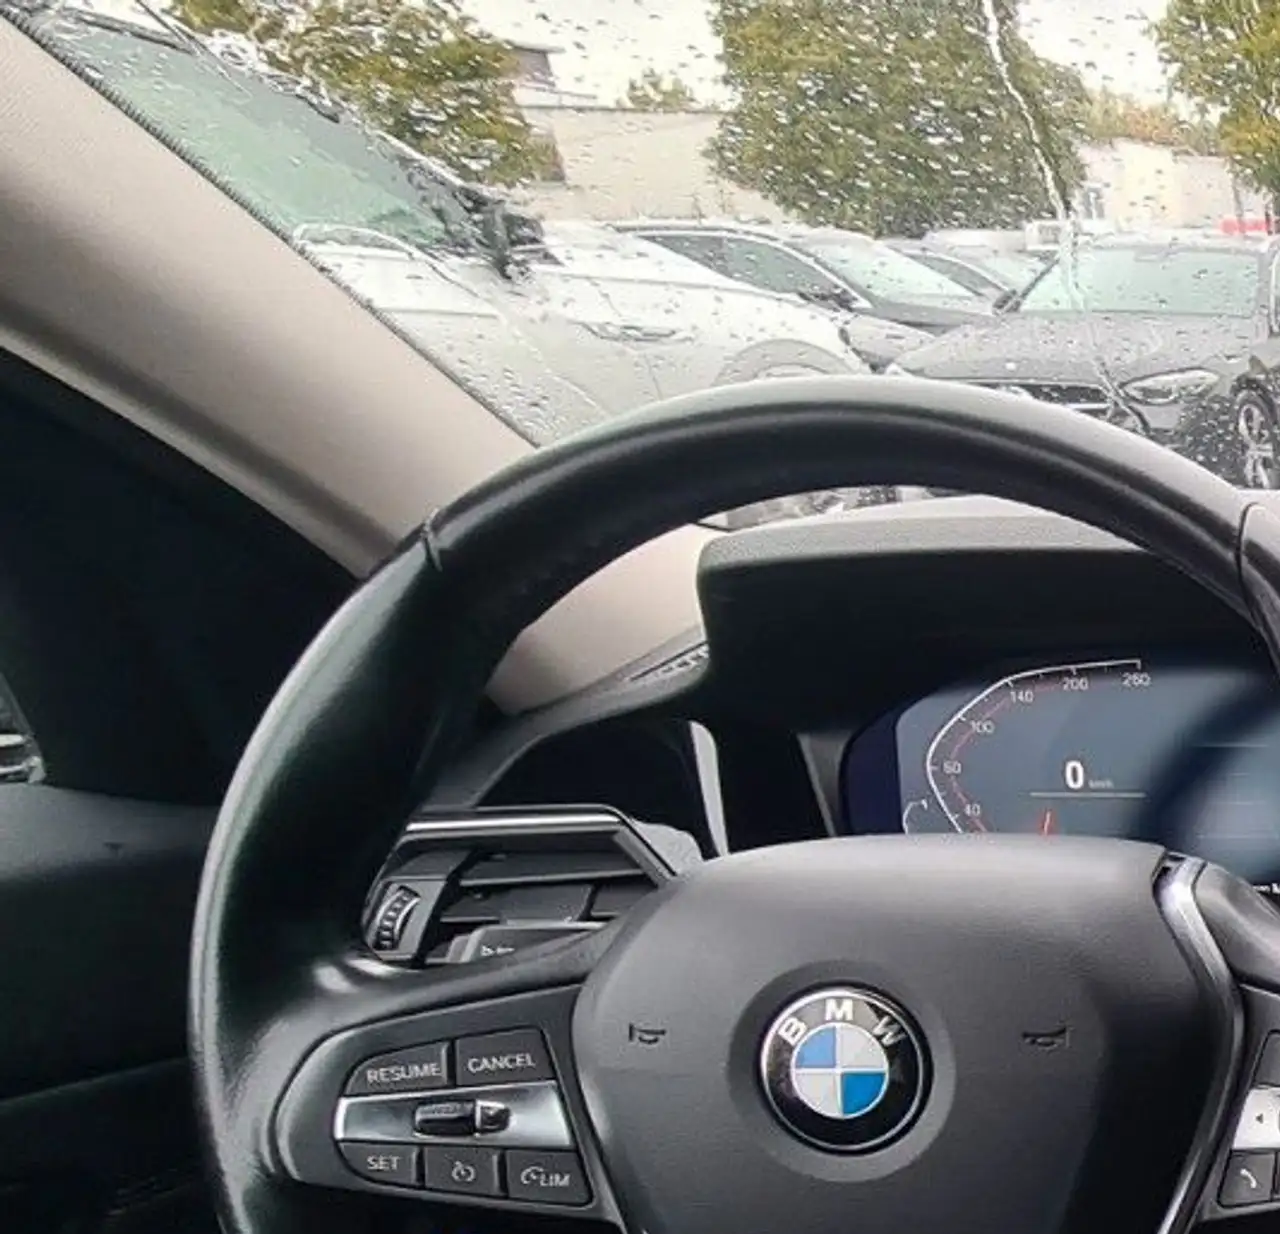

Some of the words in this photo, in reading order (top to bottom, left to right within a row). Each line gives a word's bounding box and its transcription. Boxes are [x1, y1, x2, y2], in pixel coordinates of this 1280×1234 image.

[1062, 677, 1089, 691] 200
[1122, 672, 1151, 687] 260
[1010, 690, 1034, 703] 140
[970, 720, 995, 734] 100
[1064, 760, 1085, 790] 0
[964, 803, 981, 816] 40
[778, 998, 907, 1047] BMW
[467, 1052, 536, 1074] CANCEL
[366, 1062, 442, 1084] RESUME
[367, 1155, 400, 1171] SET
[540, 1173, 570, 1187] LIM
